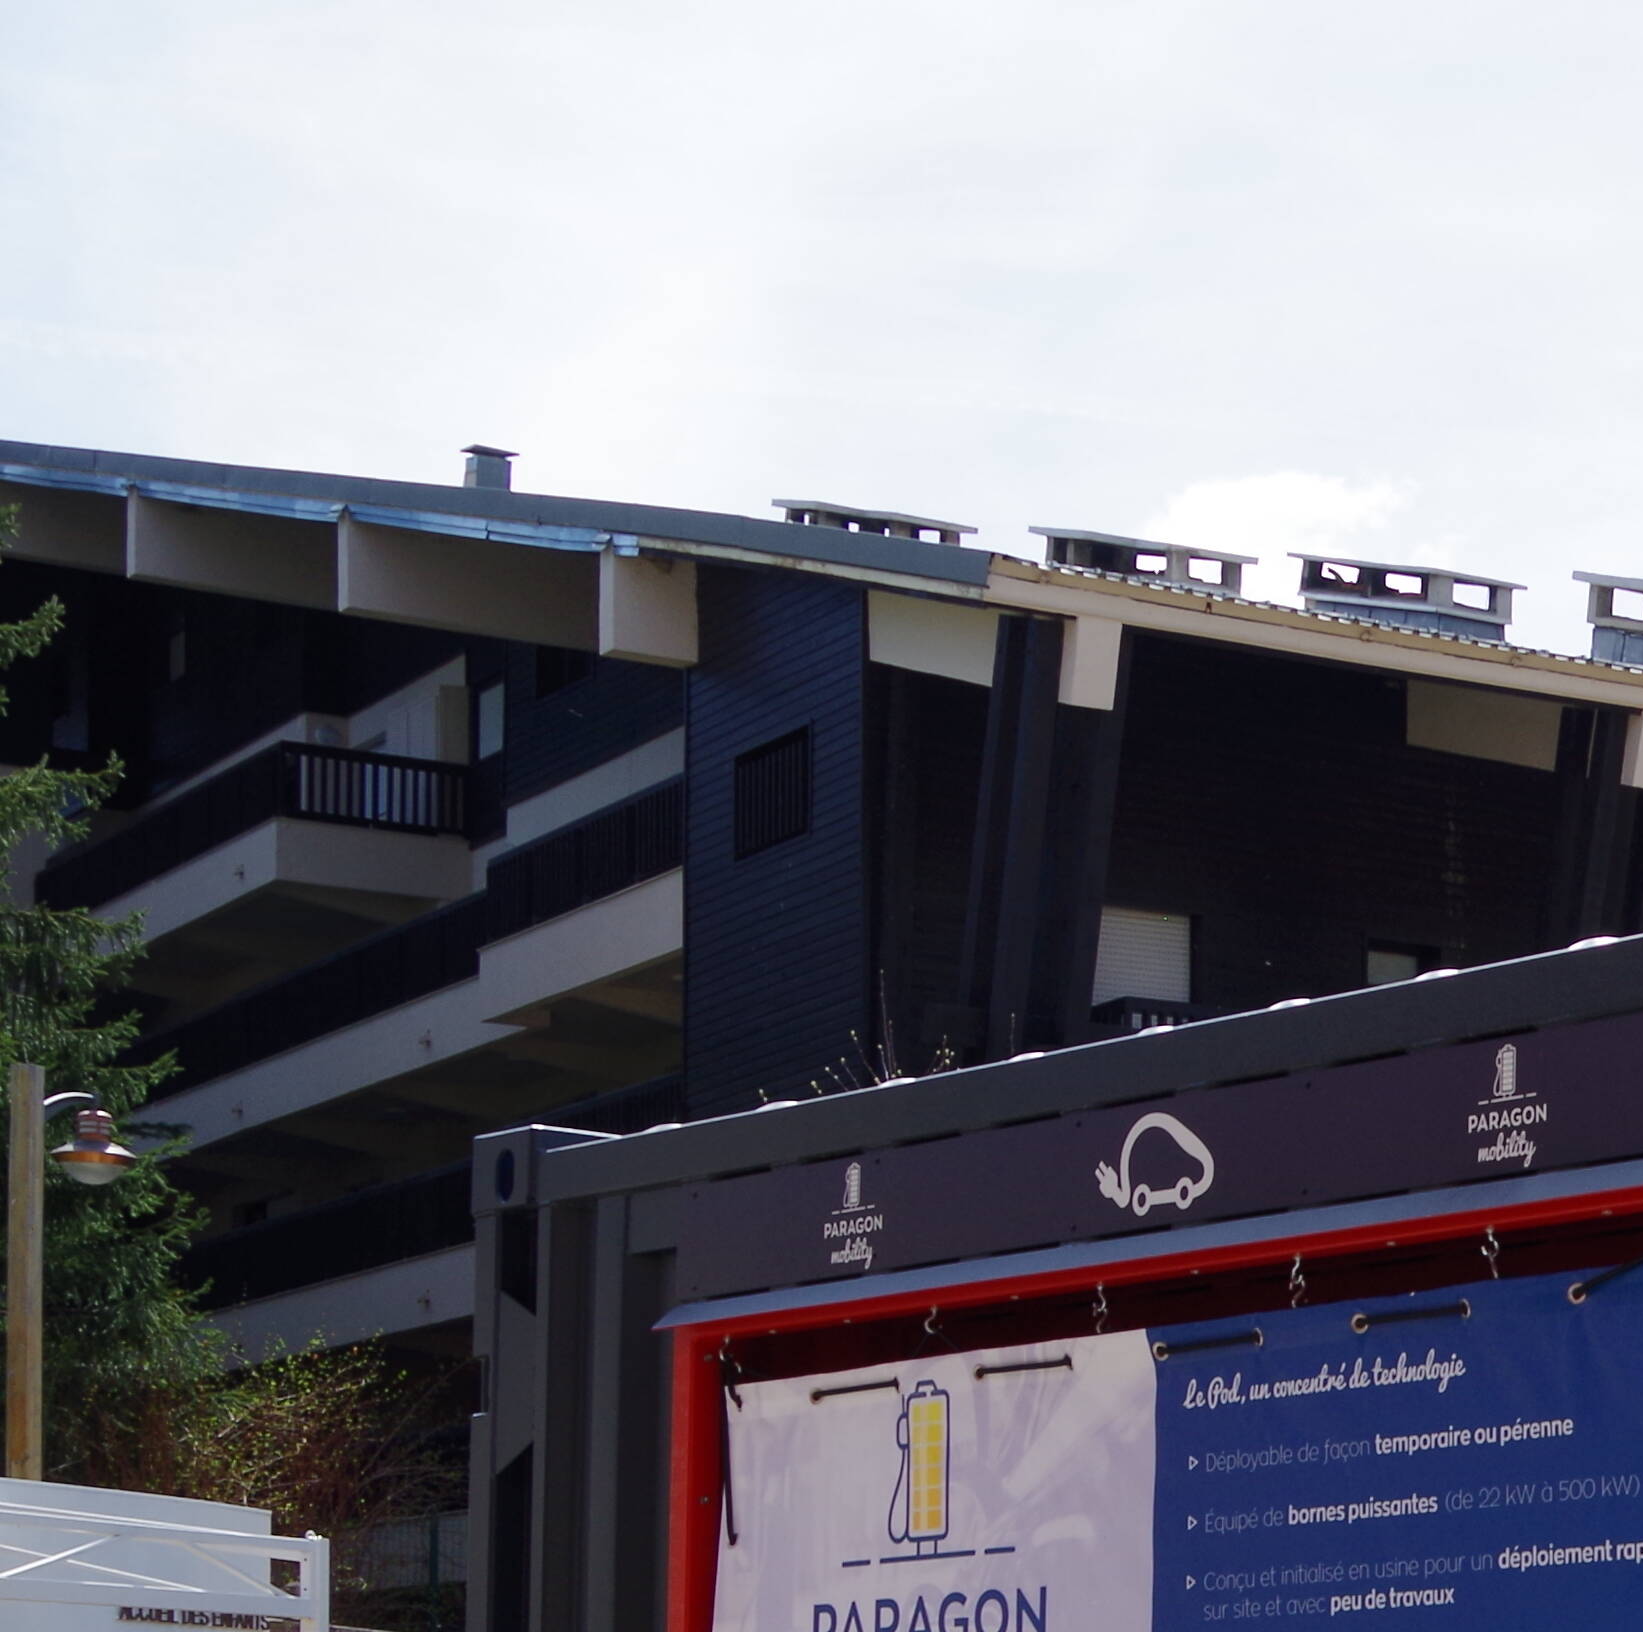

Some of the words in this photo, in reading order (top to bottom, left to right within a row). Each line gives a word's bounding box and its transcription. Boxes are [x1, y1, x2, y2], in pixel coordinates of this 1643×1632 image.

[1468, 1100, 1547, 1133] PARAGON
[1478, 1130, 1536, 1168] mobility
[824, 1211, 883, 1239] PARAGON
[831, 1237, 872, 1269] mobility
[1183, 1379, 1206, 1409] Le
[1207, 1372, 1246, 1409] Pod,
[1249, 1383, 1271, 1400] un
[1273, 1362, 1347, 1398] concentré
[1349, 1357, 1371, 1389] de
[1372, 1348, 1466, 1393] technologie
[1206, 1444, 1293, 1473] Déployable
[1297, 1442, 1319, 1462] de
[1323, 1438, 1370, 1464] façon
[1375, 1425, 1471, 1455] temporaire
[1474, 1427, 1496, 1444] ou
[1500, 1418, 1573, 1446] pérenne
[1205, 1507, 1258, 1534] Équipé
[1263, 1507, 1284, 1527] de
[1288, 1504, 1345, 1525] bornes
[1348, 1493, 1438, 1524] puissantes
[1445, 1489, 1474, 1512] (de
[1478, 1486, 1501, 1508] 22
[1506, 1484, 1536, 1505] kW
[1541, 1481, 1553, 1503] à
[1559, 1478, 1596, 1501] 500
[1601, 1475, 1640, 1497] kW)
[1203, 1571, 1255, 1593] Conçu
[1260, 1566, 1276, 1587] et
[1281, 1561, 1344, 1584] initialisé
[1348, 1564, 1370, 1580] en
[1375, 1560, 1419, 1578] usine
[1424, 1556, 1466, 1579] pour
[1471, 1554, 1493, 1571] un
[1498, 1539, 1613, 1572] déploiement
[1203, 1604, 1229, 1621] sur
[1233, 1598, 1261, 1619] site
[1265, 1595, 1281, 1616] et
[1286, 1597, 1325, 1615] avec
[1331, 1595, 1362, 1616] peu
[1365, 1588, 1386, 1609] de
[1389, 1587, 1454, 1608] travaux
